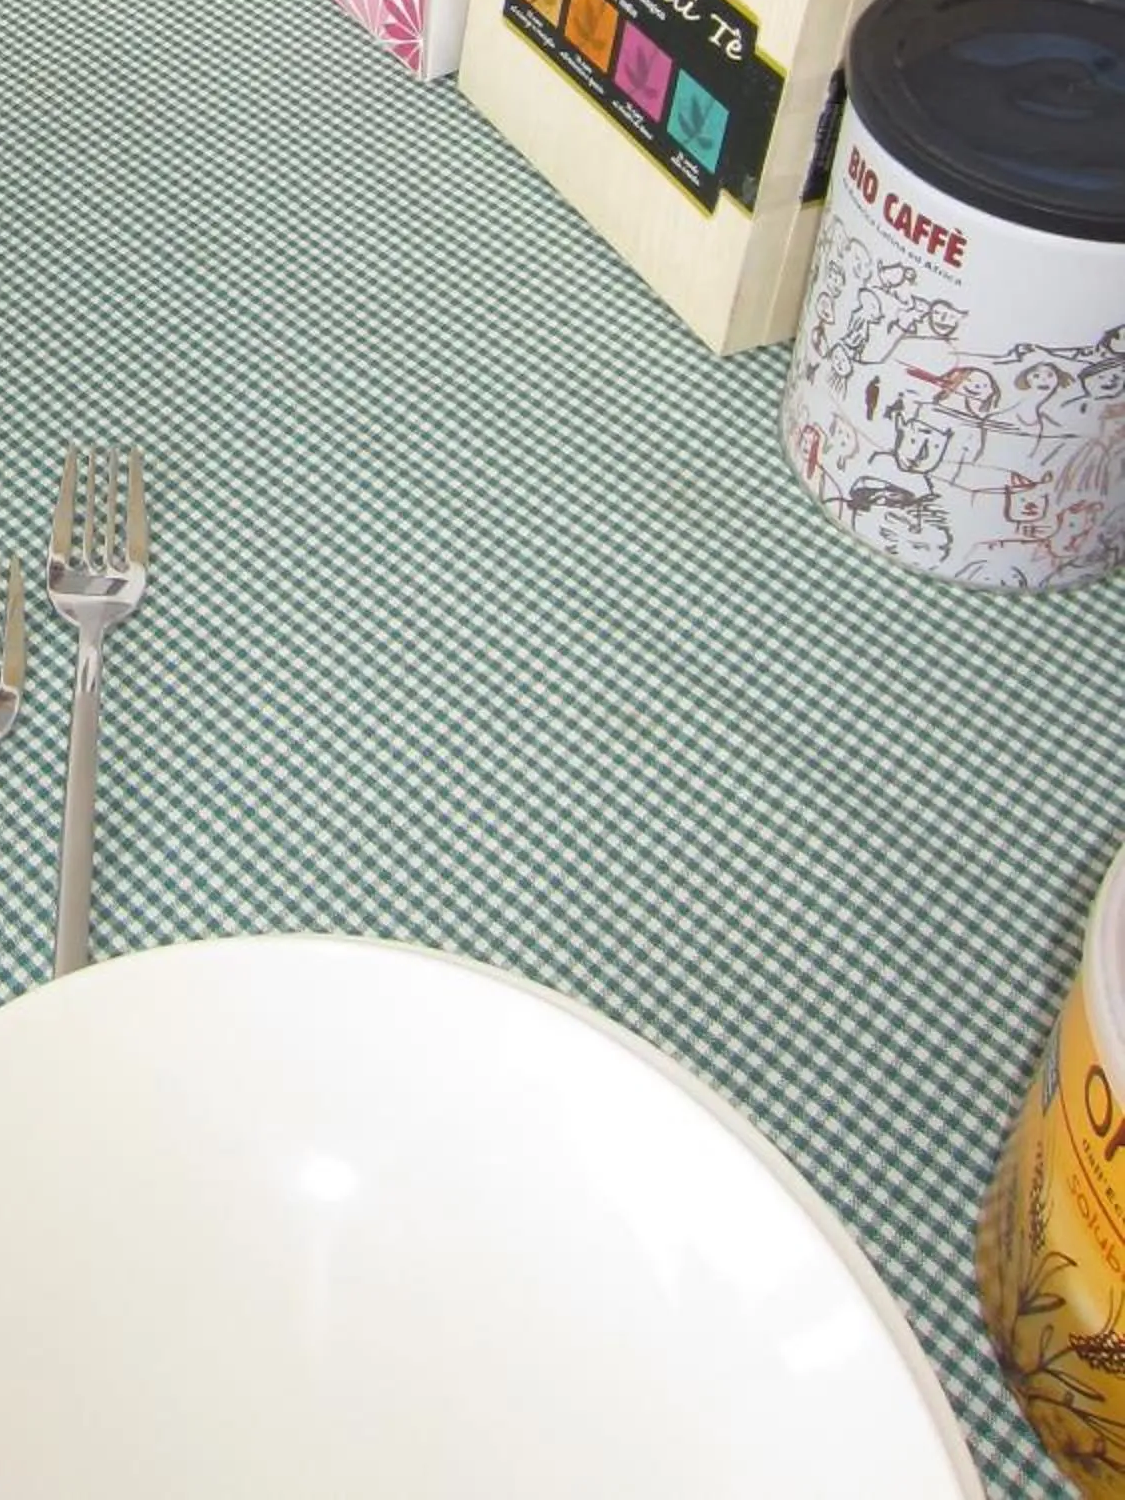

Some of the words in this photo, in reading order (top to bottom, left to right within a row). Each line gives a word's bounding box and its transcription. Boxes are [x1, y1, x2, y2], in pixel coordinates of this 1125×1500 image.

[708, 13, 743, 61] Tè
[848, 145, 880, 205] BIO
[883, 192, 968, 269] CAFFÈ
